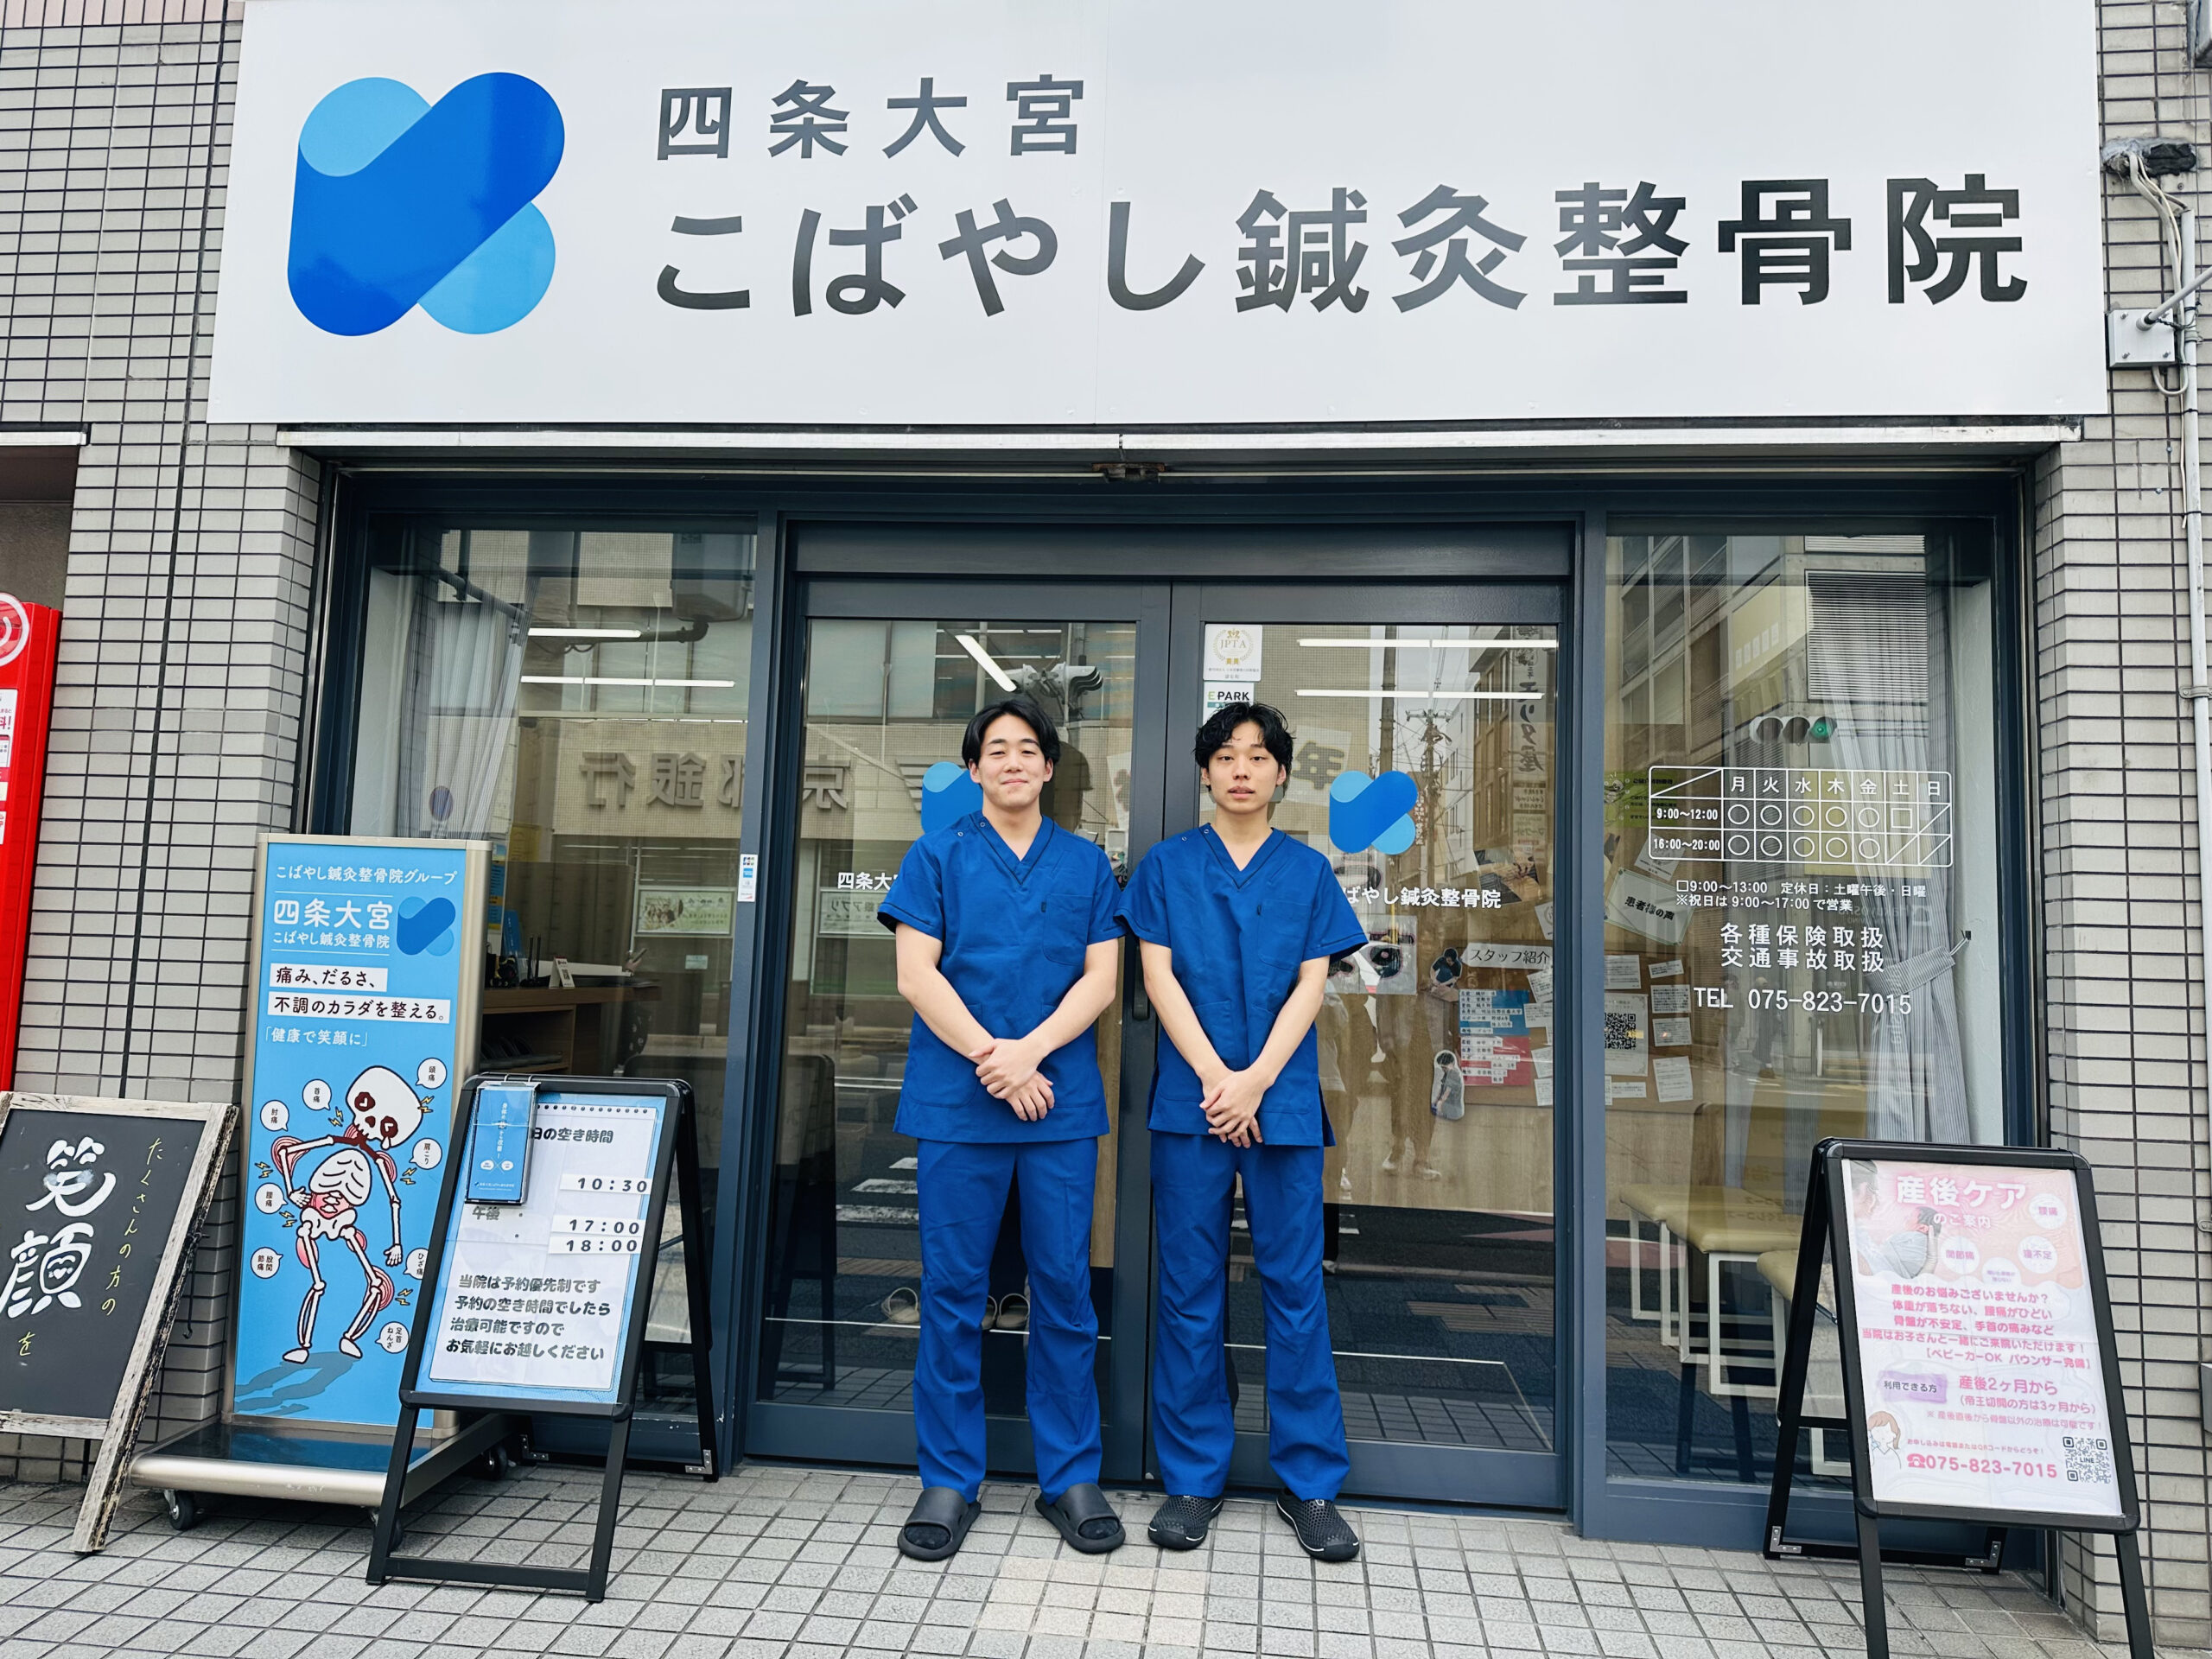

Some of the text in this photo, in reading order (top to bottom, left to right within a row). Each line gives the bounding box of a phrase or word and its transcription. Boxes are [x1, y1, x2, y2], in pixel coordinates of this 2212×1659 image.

[657, 74, 1084, 160] 四条大宮
[657, 173, 2028, 316] こばやし鍼灸整骨院
[1220, 639, 1246, 648] JPTA
[1731, 776, 1941, 797] 月 火 水 木 金 土 日
[276, 865, 457, 885] こばやし鍼灸整骨院グループ
[837, 872, 899, 891] 四条大
[274, 898, 393, 930] 四条大宮
[1624, 896, 1675, 920] 患者様の声
[273, 931, 390, 949] こばやし鍼灸整骨院
[1720, 922, 1884, 949] 各種保険取扱
[1471, 948, 1550, 965] スタッフ紹介
[1720, 946, 1885, 973] 交通事故取扱
[276, 966, 375, 988] 痛み、だるさ、
[274, 996, 444, 1021] 不調のカラダを整える。
[1694, 987, 1733, 1009] TEL
[1748, 988, 1912, 1015] 075-823-7015
[265, 1026, 369, 1046] 「健康で笑顔に」
[577, 1177, 648, 1192] 10:30
[1897, 1175, 2026, 1210] 産後ケア
[472, 1205, 500, 1221] 午後
[1933, 1212, 1991, 1229] のご案内
[101, 1137, 164, 1316] たくさんの方の
[569, 1218, 640, 1235] 17:00
[566, 1239, 638, 1253] 18:00
[458, 1274, 601, 1294] 当院は予約優先制です
[1891, 1284, 2049, 1305] 産後のお悩みございませんか？
[454, 1295, 611, 1316] 予約の空き時間でしたら
[450, 1317, 565, 1337] 治療可能ですので
[18, 1331, 35, 1357] を
[446, 1338, 605, 1360] お気軽にお越しください
[1884, 1380, 1937, 1394] 利用できる方
[1926, 1455, 2057, 1478] 075-823-7015
